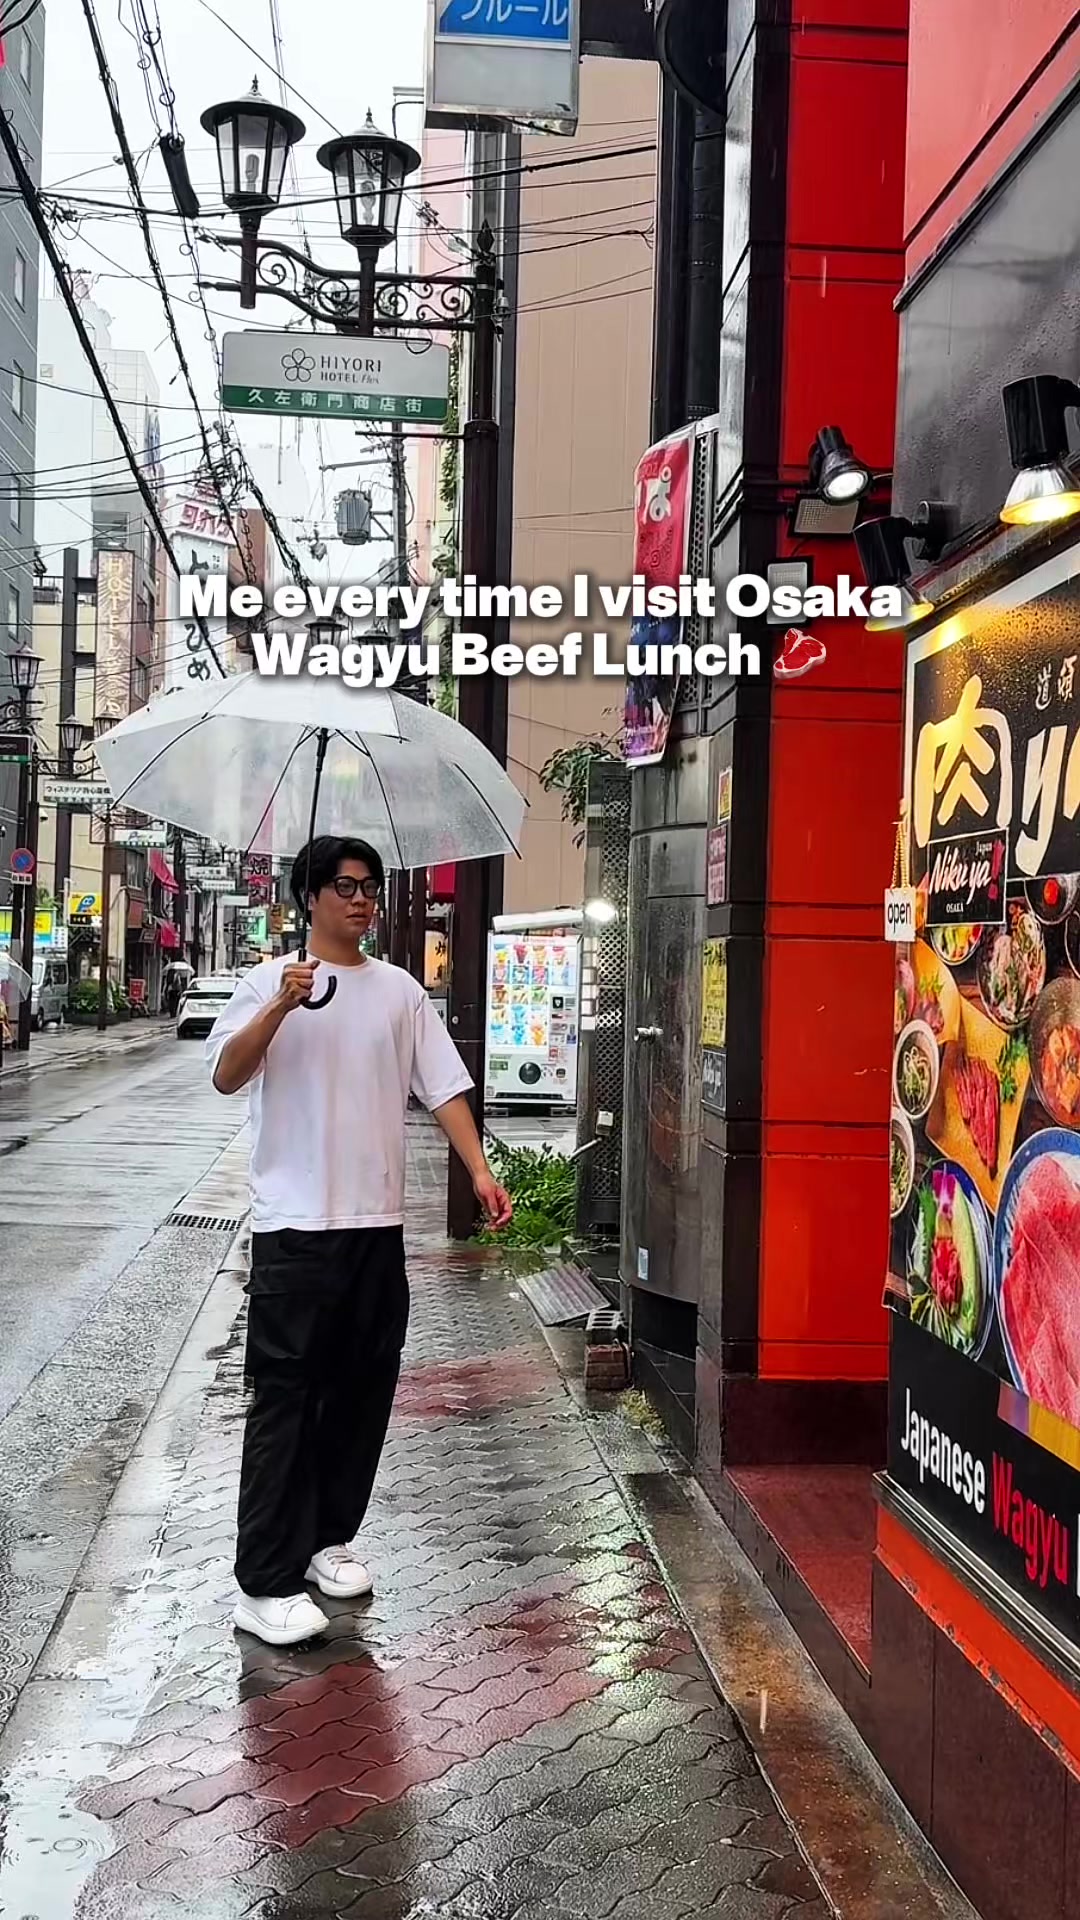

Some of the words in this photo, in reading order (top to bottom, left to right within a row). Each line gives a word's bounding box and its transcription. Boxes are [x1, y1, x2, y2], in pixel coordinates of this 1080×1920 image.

[320, 354, 382, 372] HIYORI
[320, 370, 358, 383] HOTEL
[248, 389, 423, 413] 久左衛門商店街
[887, 903, 912, 934] open
[900, 1387, 986, 1515] Japanese
[991, 1451, 1071, 1588] Wagyu
